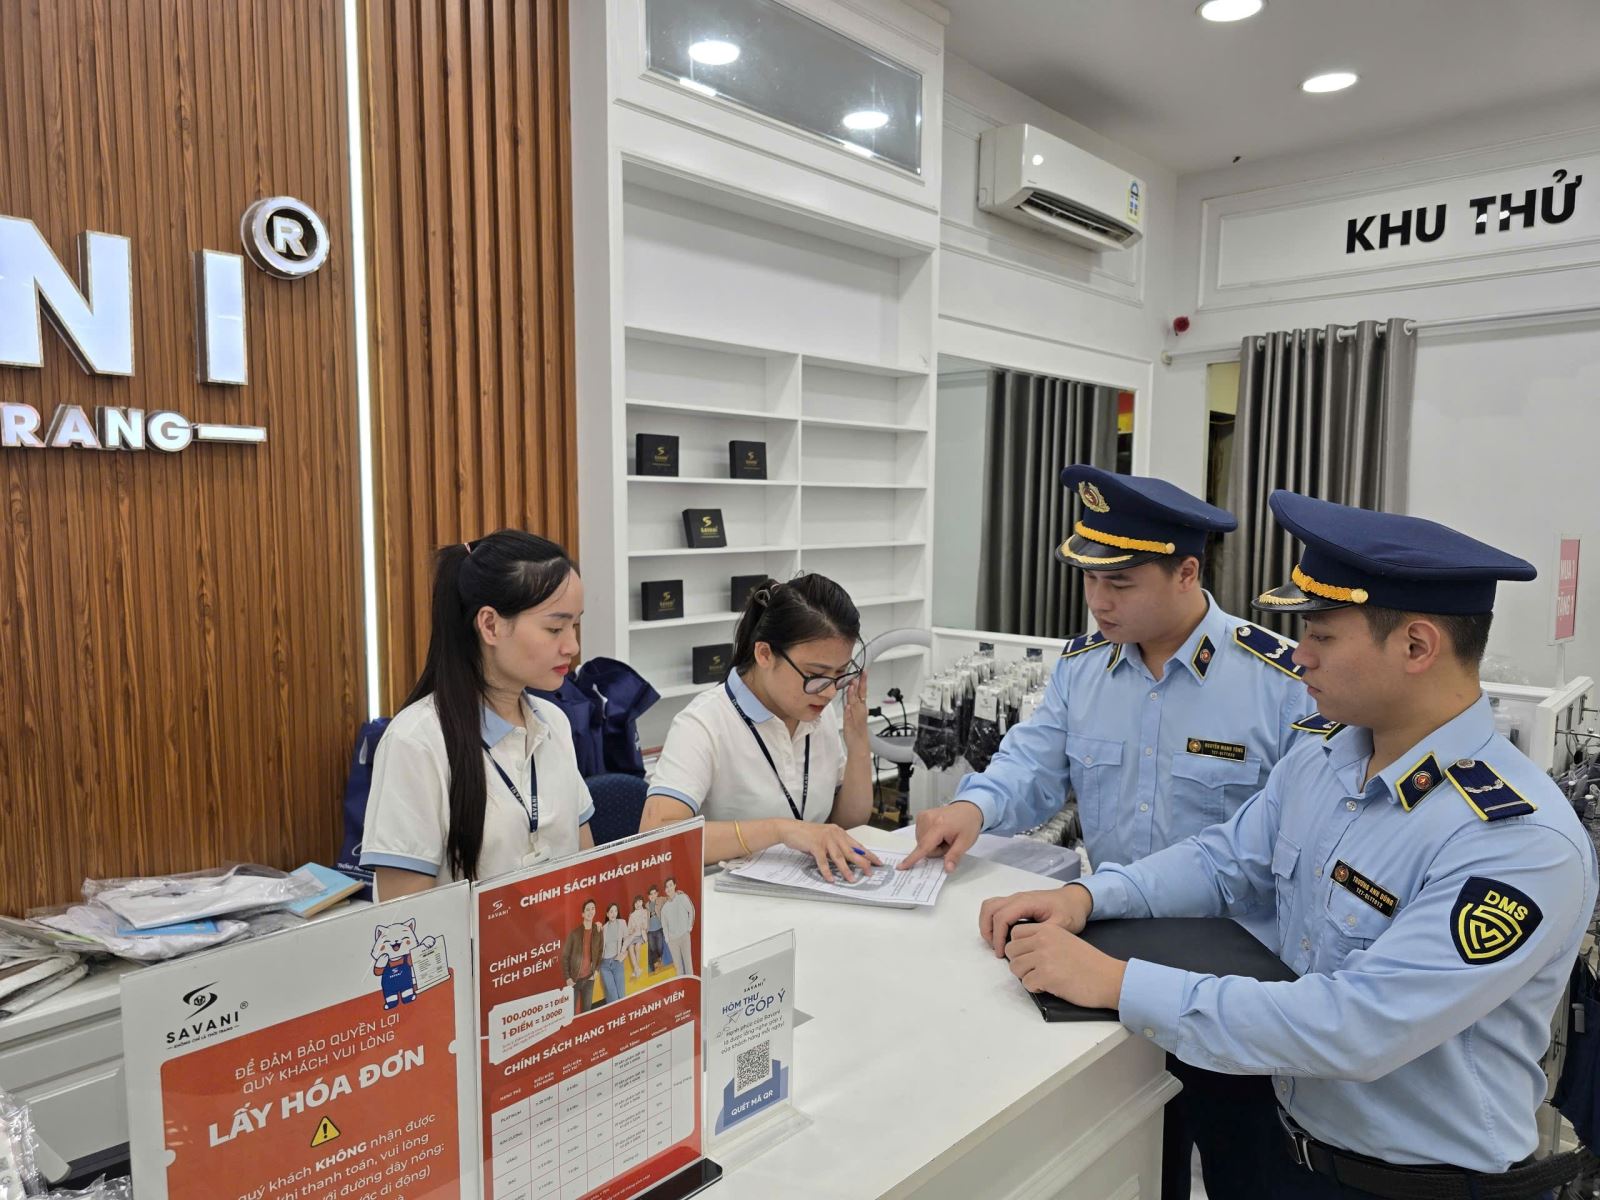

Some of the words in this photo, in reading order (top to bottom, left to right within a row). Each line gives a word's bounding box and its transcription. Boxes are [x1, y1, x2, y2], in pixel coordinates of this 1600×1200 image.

[1346, 203, 1447, 254] KHU
[1469, 169, 1583, 235] THỬ
[1, 402, 194, 452] RANG
[520, 886, 561, 908] CHÍNH
[564, 876, 596, 895] SÁCH
[599, 862, 639, 883] KHÁCH
[642, 851, 673, 870] HÀNG
[1484, 890, 1529, 921] DMS
[489, 950, 528, 974] CHÍNH
[530, 939, 562, 958] SÁCH
[492, 969, 521, 989] TÍCH
[744, 983, 764, 993] SAVANI
[502, 1004, 544, 1026] 100.000Đ
[554, 995, 570, 1006] ĐIỂM
[722, 1000, 742, 1015] HÒM
[744, 992, 759, 1006] THƯ
[744, 996, 774, 1017] GÓP
[778, 988, 786, 1003] Ý
[166, 1011, 239, 1044] SAVANI
[502, 1032, 506, 1040] 1
[509, 1021, 534, 1037] ĐIỂM
[504, 1053, 541, 1076] CHÍNH
[543, 1038, 572, 1059] SÁCH
[575, 1026, 605, 1045] HẠNG
[606, 1015, 626, 1032] THẺ
[628, 1000, 662, 1021] THÀNH
[664, 990, 686, 1006] VIÊN
[235, 1058, 256, 1080] ĐỂ
[260, 1050, 292, 1072] ĐẢM
[297, 1039, 326, 1058] BẢO
[330, 1022, 376, 1046] QUYỀN
[380, 1013, 400, 1029] LỢI
[243, 1073, 274, 1094] QUÝ
[279, 1056, 328, 1081] KHÁCH
[332, 1046, 356, 1061] VUI
[360, 1030, 395, 1052] LÒNG
[208, 1102, 273, 1148] LẤY
[281, 1074, 352, 1120] HÓA
[358, 1045, 424, 1089] ĐƠN
[731, 1100, 750, 1116] QUÉT
[750, 1096, 762, 1108] MÃ
[762, 1089, 774, 1100] QR
[269, 1166, 312, 1193] khách
[315, 1141, 367, 1172] KHÔNG
[370, 1128, 402, 1149] nhận
[405, 1112, 436, 1133] được
[302, 1171, 342, 1196] thanh
[346, 1156, 378, 1177] toán,
[380, 1144, 399, 1161] vui
[402, 1132, 430, 1152] lòng
[340, 1172, 382, 1197] đường
[386, 1159, 408, 1176] dây
[411, 1144, 445, 1164] nóng:
[380, 1182, 393, 1196] di
[395, 1165, 432, 1190] động)
